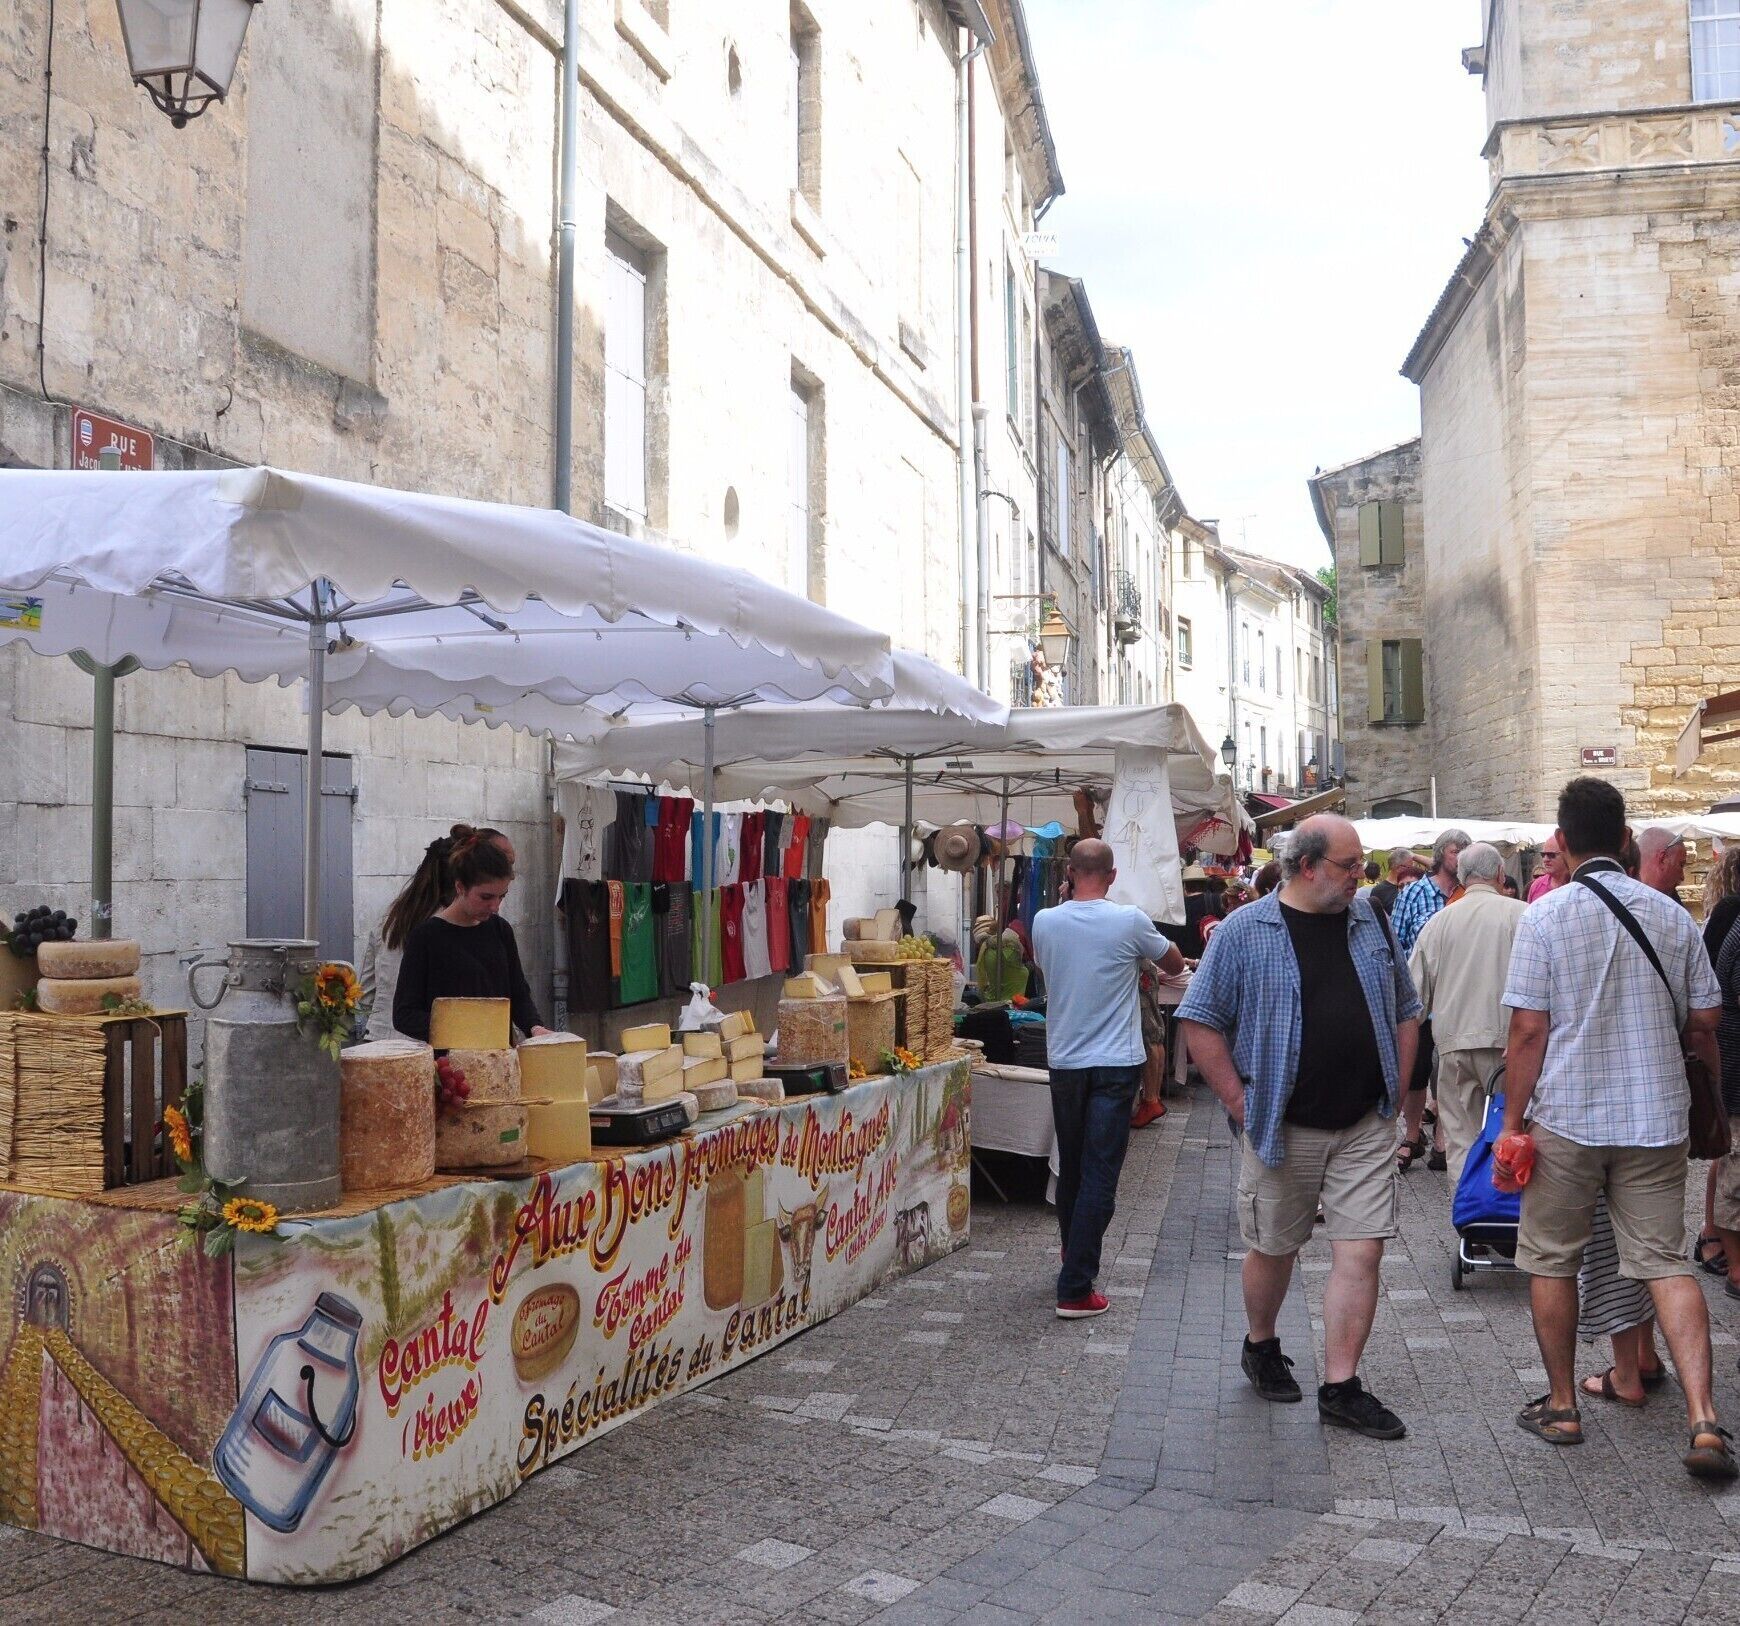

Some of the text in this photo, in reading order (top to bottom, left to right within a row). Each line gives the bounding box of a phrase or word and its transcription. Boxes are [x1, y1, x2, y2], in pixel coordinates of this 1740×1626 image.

[79, 450, 100, 471] Jacq
[110, 432, 137, 456] RUE
[490, 1172, 597, 1302] Aux
[590, 1139, 678, 1270] Bons
[781, 1121, 800, 1166] de
[799, 1093, 890, 1190] Montagnes
[825, 1170, 874, 1262] Cantal
[535, 1312, 547, 1328] du
[594, 1229, 693, 1339] Tomme du
[627, 1266, 685, 1354] Cantal
[379, 1290, 487, 1417] Cantal
[516, 1270, 812, 1478] Spécialités du Cantal
[522, 1309, 565, 1351] Cantal
